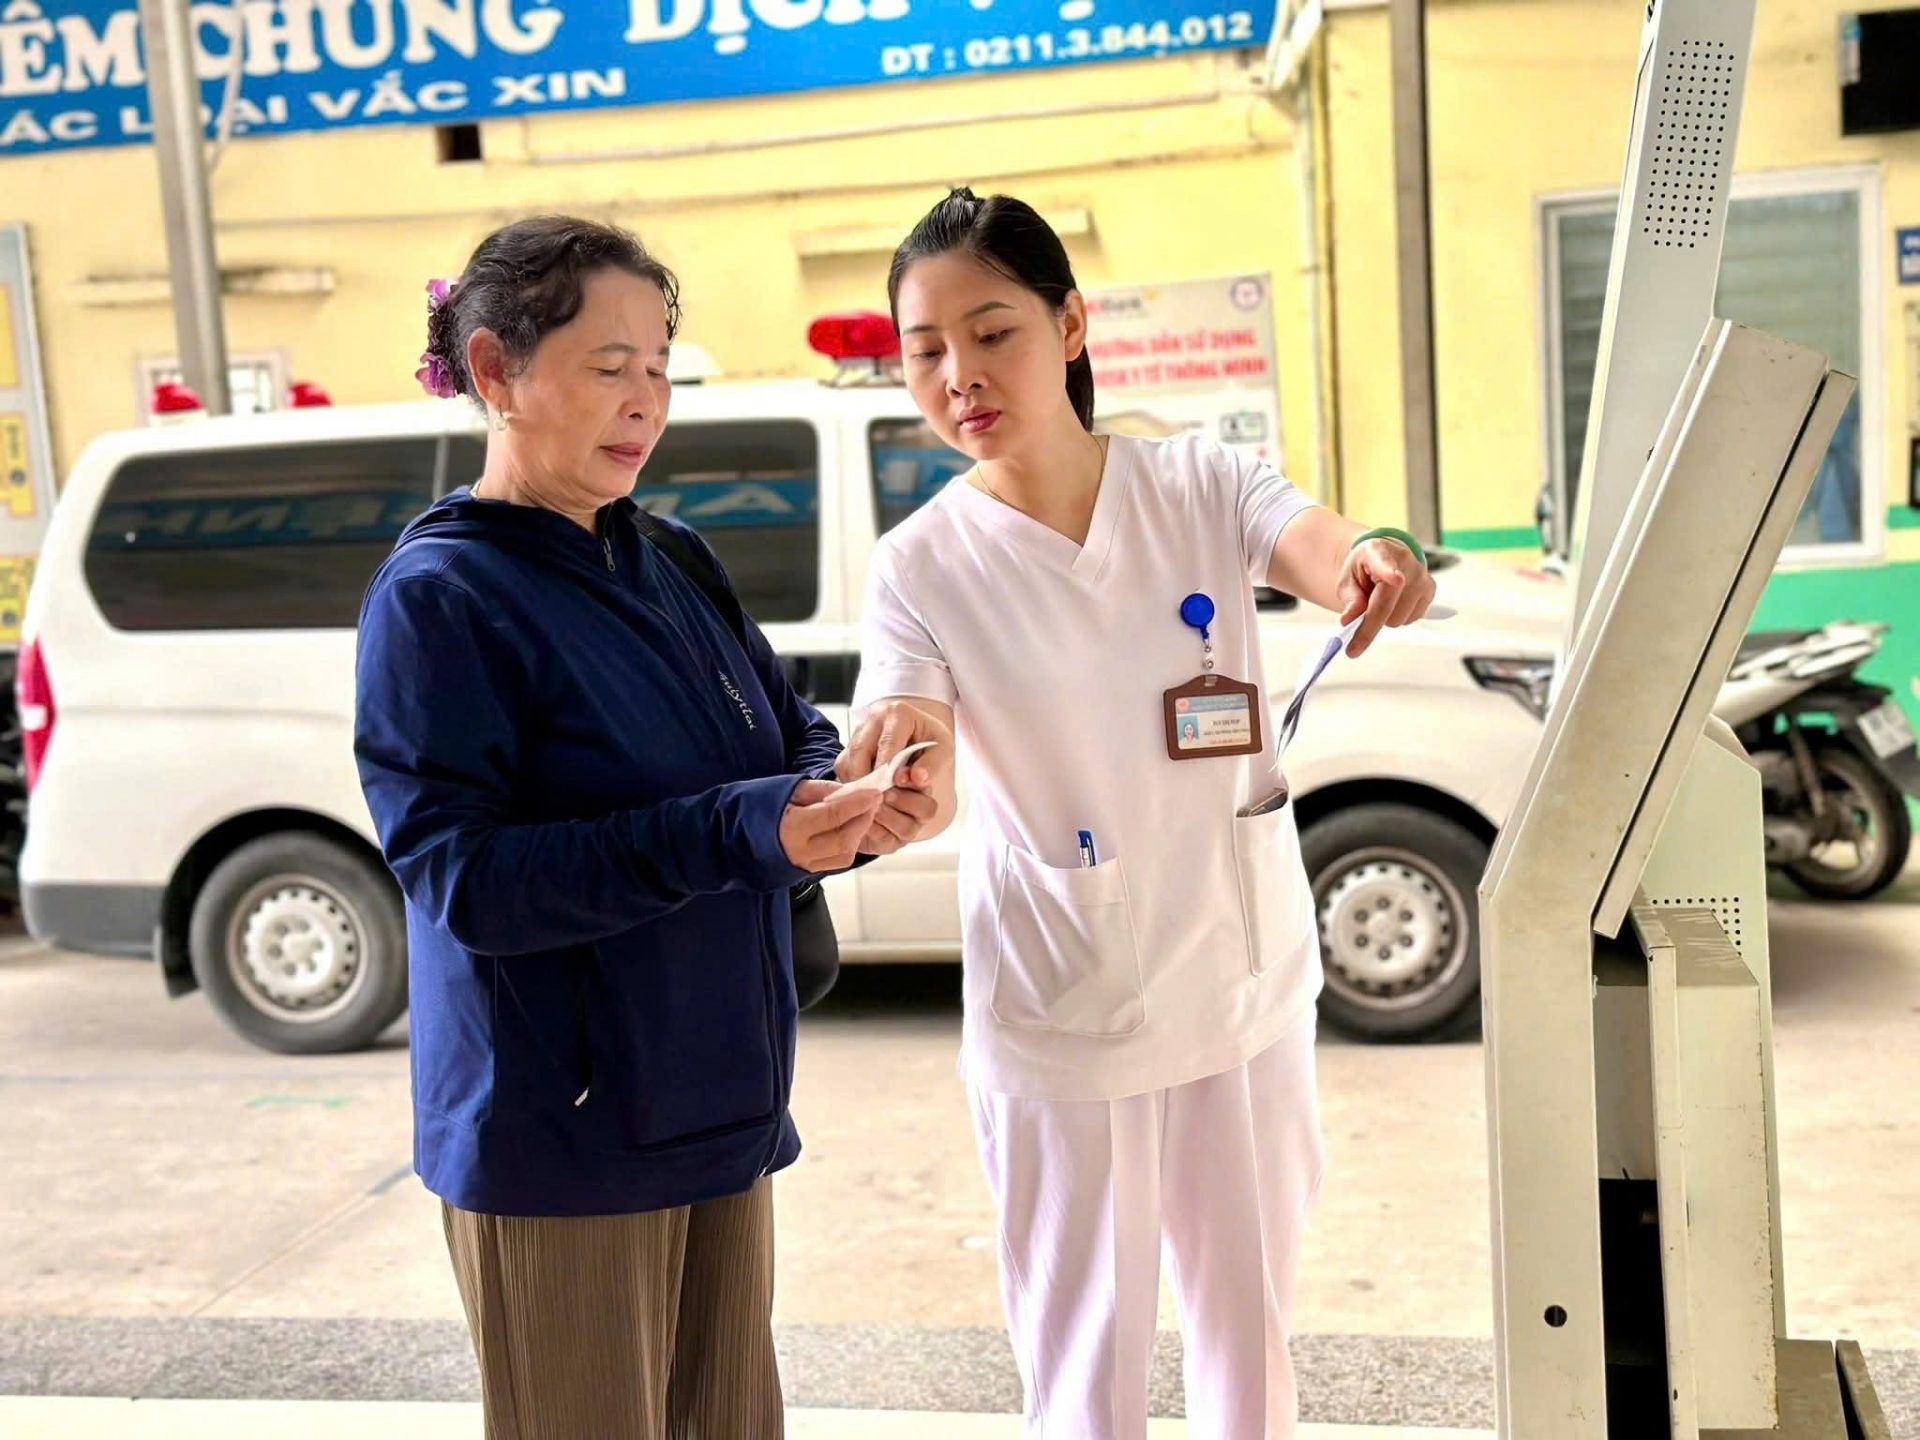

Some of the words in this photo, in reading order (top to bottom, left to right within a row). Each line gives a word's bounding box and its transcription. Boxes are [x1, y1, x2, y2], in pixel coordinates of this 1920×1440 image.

[963, 11, 1253, 68] 0211.3.844.012
[119, 95, 288, 135] LẠI
[308, 69, 469, 120] VẮC
[493, 66, 627, 107] XIN
